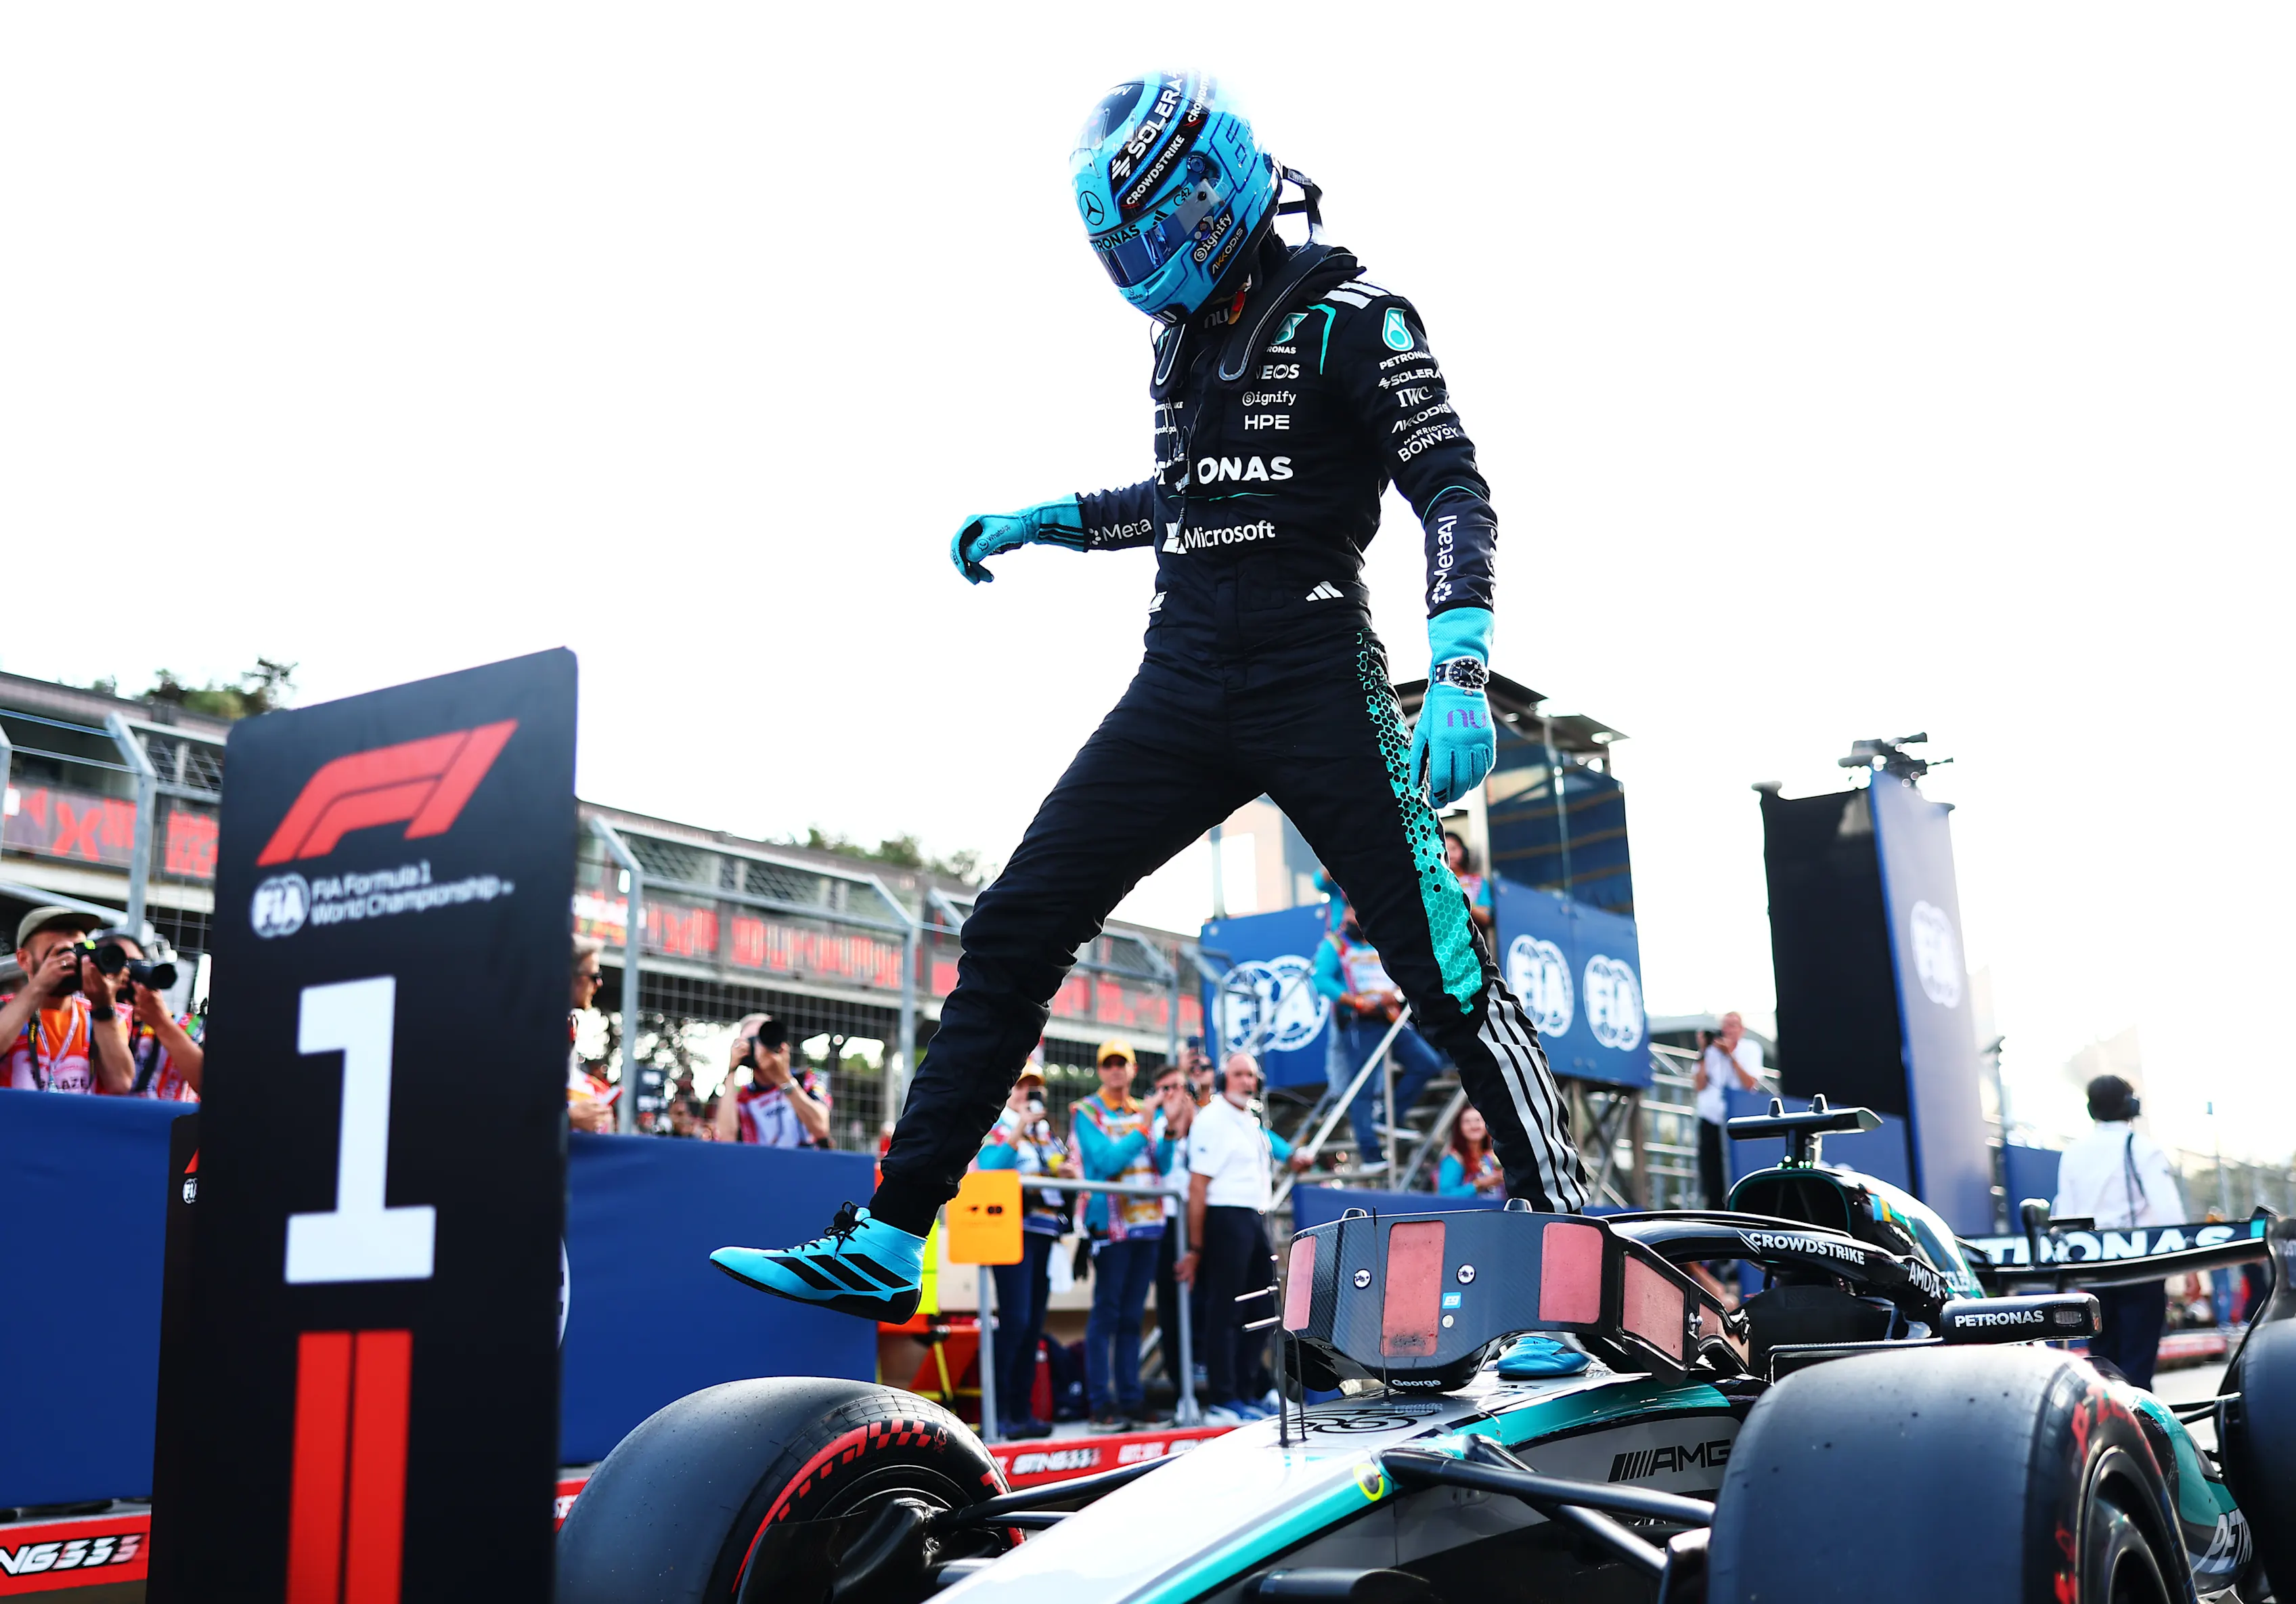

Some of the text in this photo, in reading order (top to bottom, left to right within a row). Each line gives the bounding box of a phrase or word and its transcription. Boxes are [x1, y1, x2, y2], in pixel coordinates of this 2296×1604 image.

[1128, 79, 1183, 160] SOLERA
[1126, 134, 1185, 204] CROWDSTRIKE
[1265, 345, 1296, 354] RONAS
[1390, 368, 1442, 387] SOLERA
[1396, 386, 1433, 408] IWC
[1244, 414, 1290, 431] HPE
[1404, 423, 1448, 446] MARRIOTT
[1397, 427, 1459, 462] BONVOY
[1101, 518, 1153, 542] Meta
[1185, 519, 1276, 549] Microsoft
[343, 867, 419, 896] Formula
[420, 861, 432, 884] 1
[253, 885, 303, 928] FIA
[311, 875, 500, 926] World Championship
[1511, 951, 1566, 1020] FIA
[1586, 972, 1637, 1033] FIA
[285, 975, 436, 1284] 1
[1749, 1232, 1866, 1265] CROWDSTRIKE
[1954, 1309, 2044, 1328] PETRONAS
[1392, 1379, 1442, 1387] George
[1648, 1439, 1731, 1477] AMG
